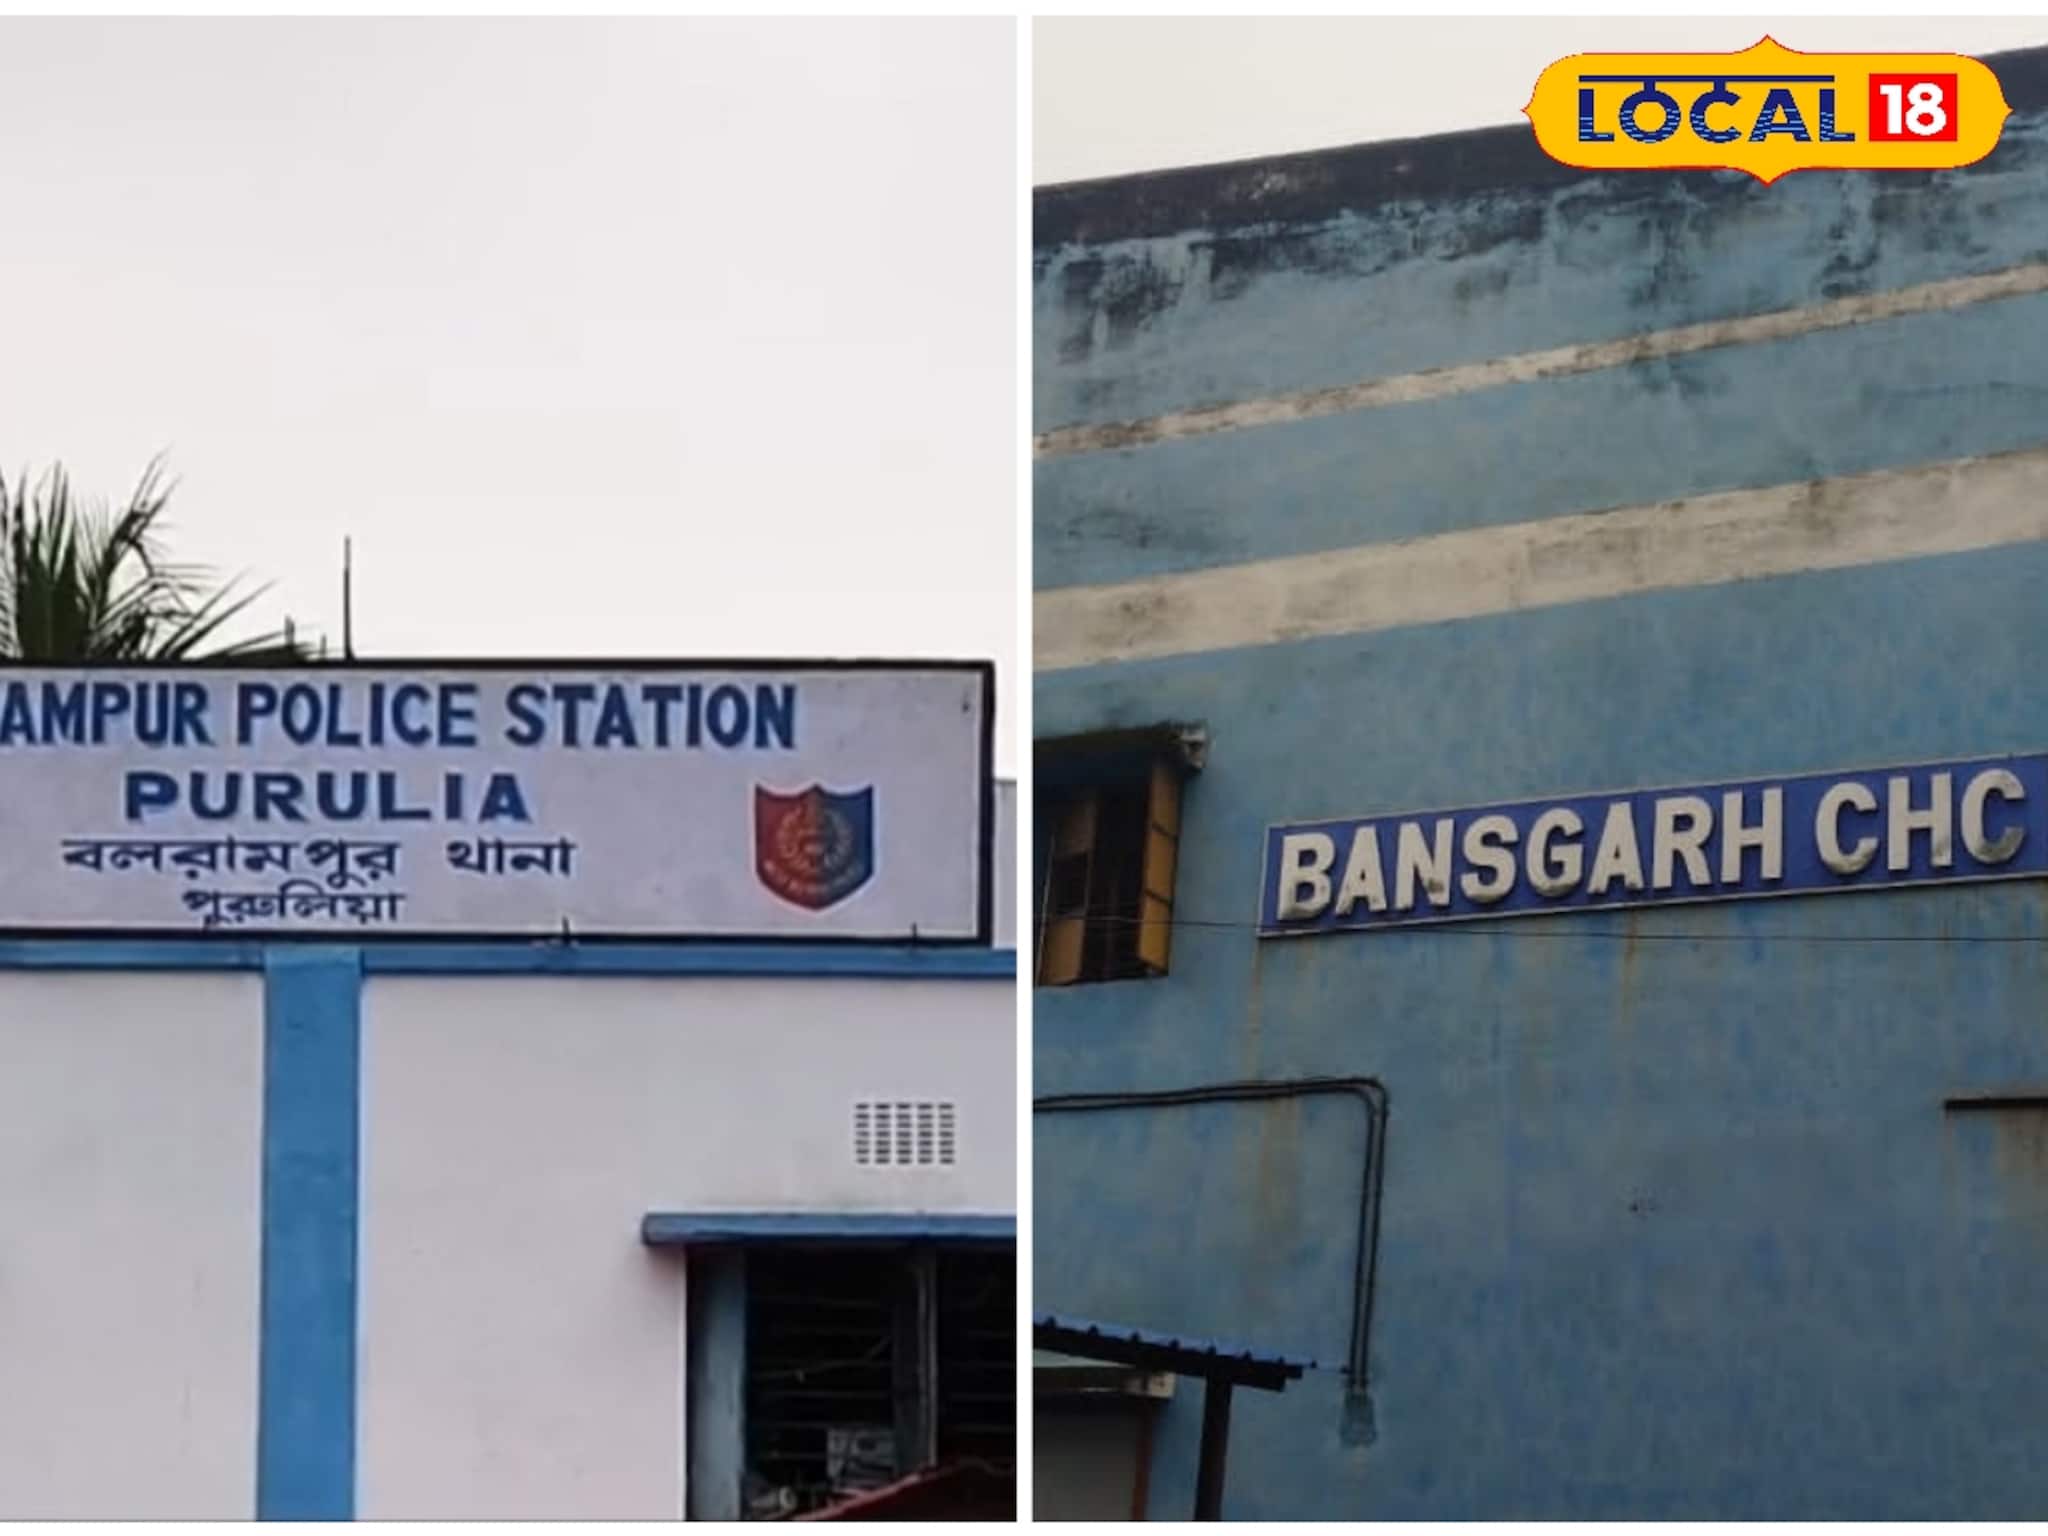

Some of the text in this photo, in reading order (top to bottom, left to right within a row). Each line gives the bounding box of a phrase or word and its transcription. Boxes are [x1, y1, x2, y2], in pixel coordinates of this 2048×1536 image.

[0, 681, 797, 749] AMPUR POLICE STATION
[125, 771, 532, 822] PURULIA
[446, 837, 577, 877] থানা
[1278, 768, 2028, 922] BANSGARH CHC
